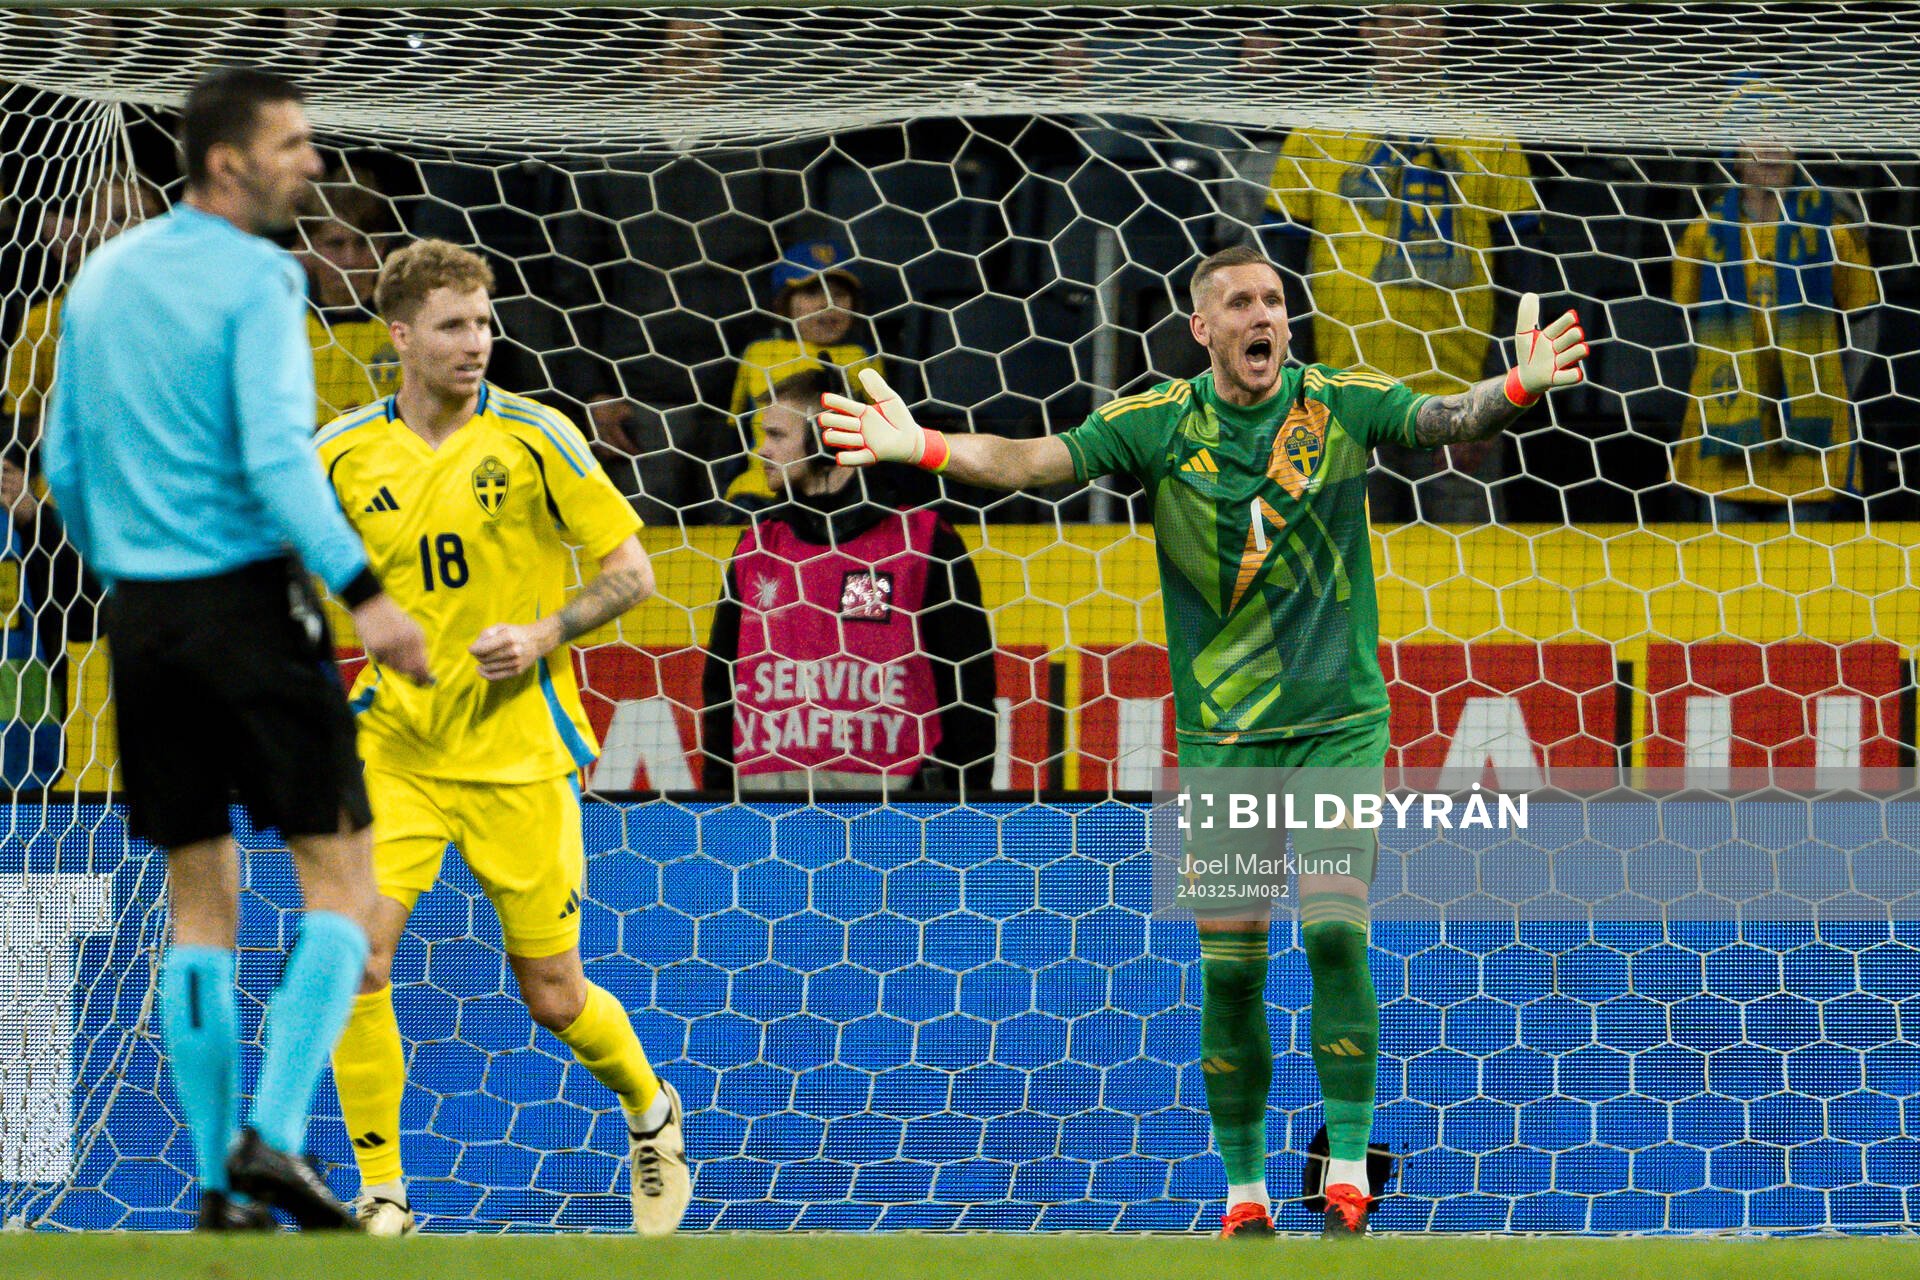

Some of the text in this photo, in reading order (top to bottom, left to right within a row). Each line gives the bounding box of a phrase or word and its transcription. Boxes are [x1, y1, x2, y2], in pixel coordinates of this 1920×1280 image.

[1250, 497, 1267, 551] 1
[420, 532, 469, 592] 18
[755, 660, 907, 705] SERVICE
[761, 709, 905, 754] SAFETY
